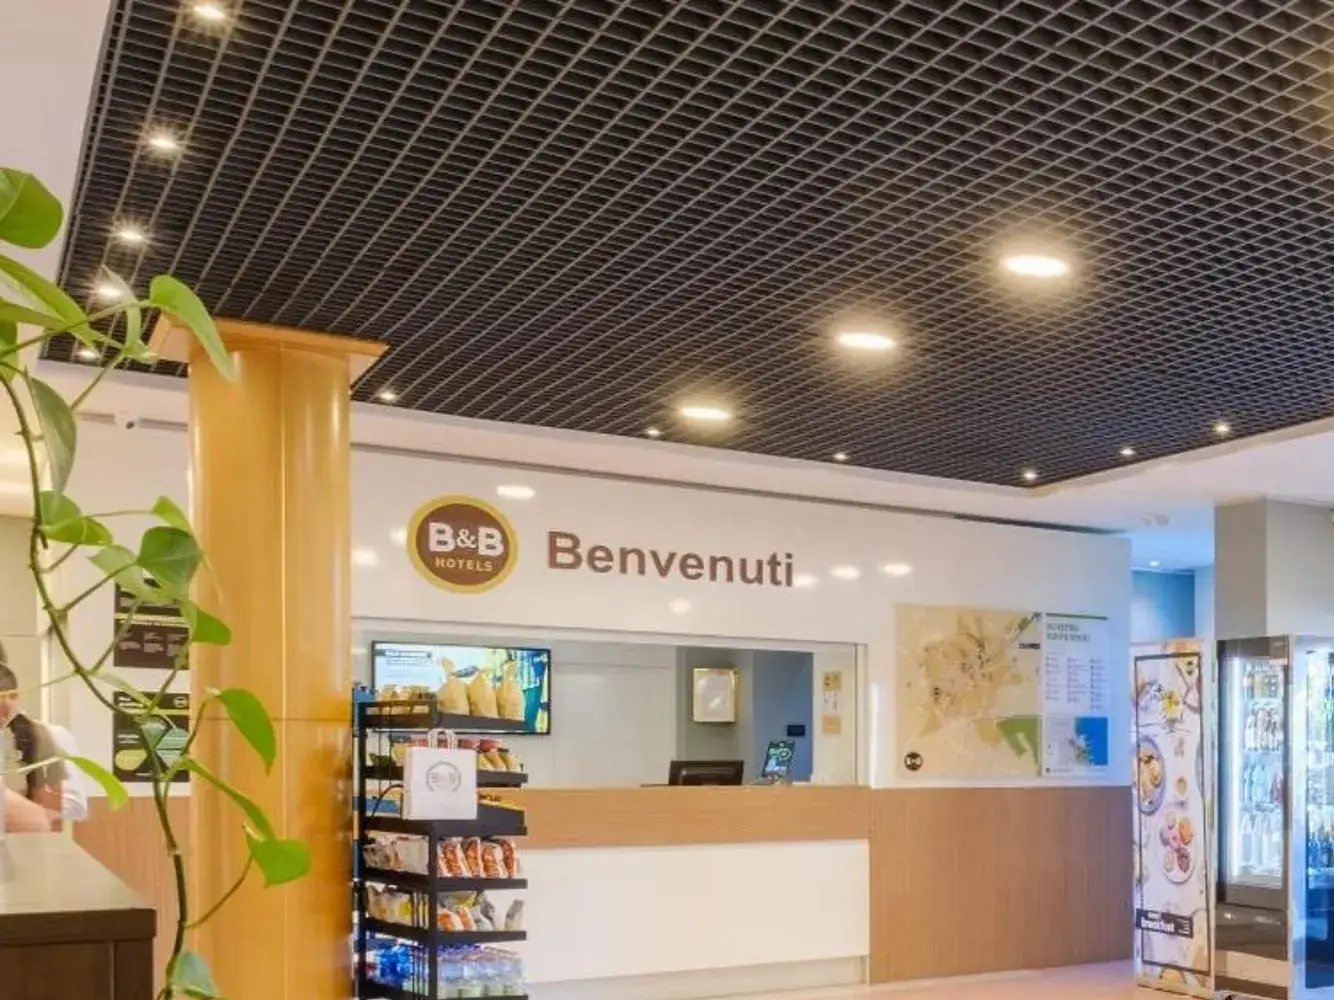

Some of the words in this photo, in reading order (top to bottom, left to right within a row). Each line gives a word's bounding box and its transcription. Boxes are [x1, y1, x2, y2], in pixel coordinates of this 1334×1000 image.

[427, 521, 505, 558] B&B
[434, 556, 494, 572] HOTELS
[547, 529, 795, 588] Benvenuti
